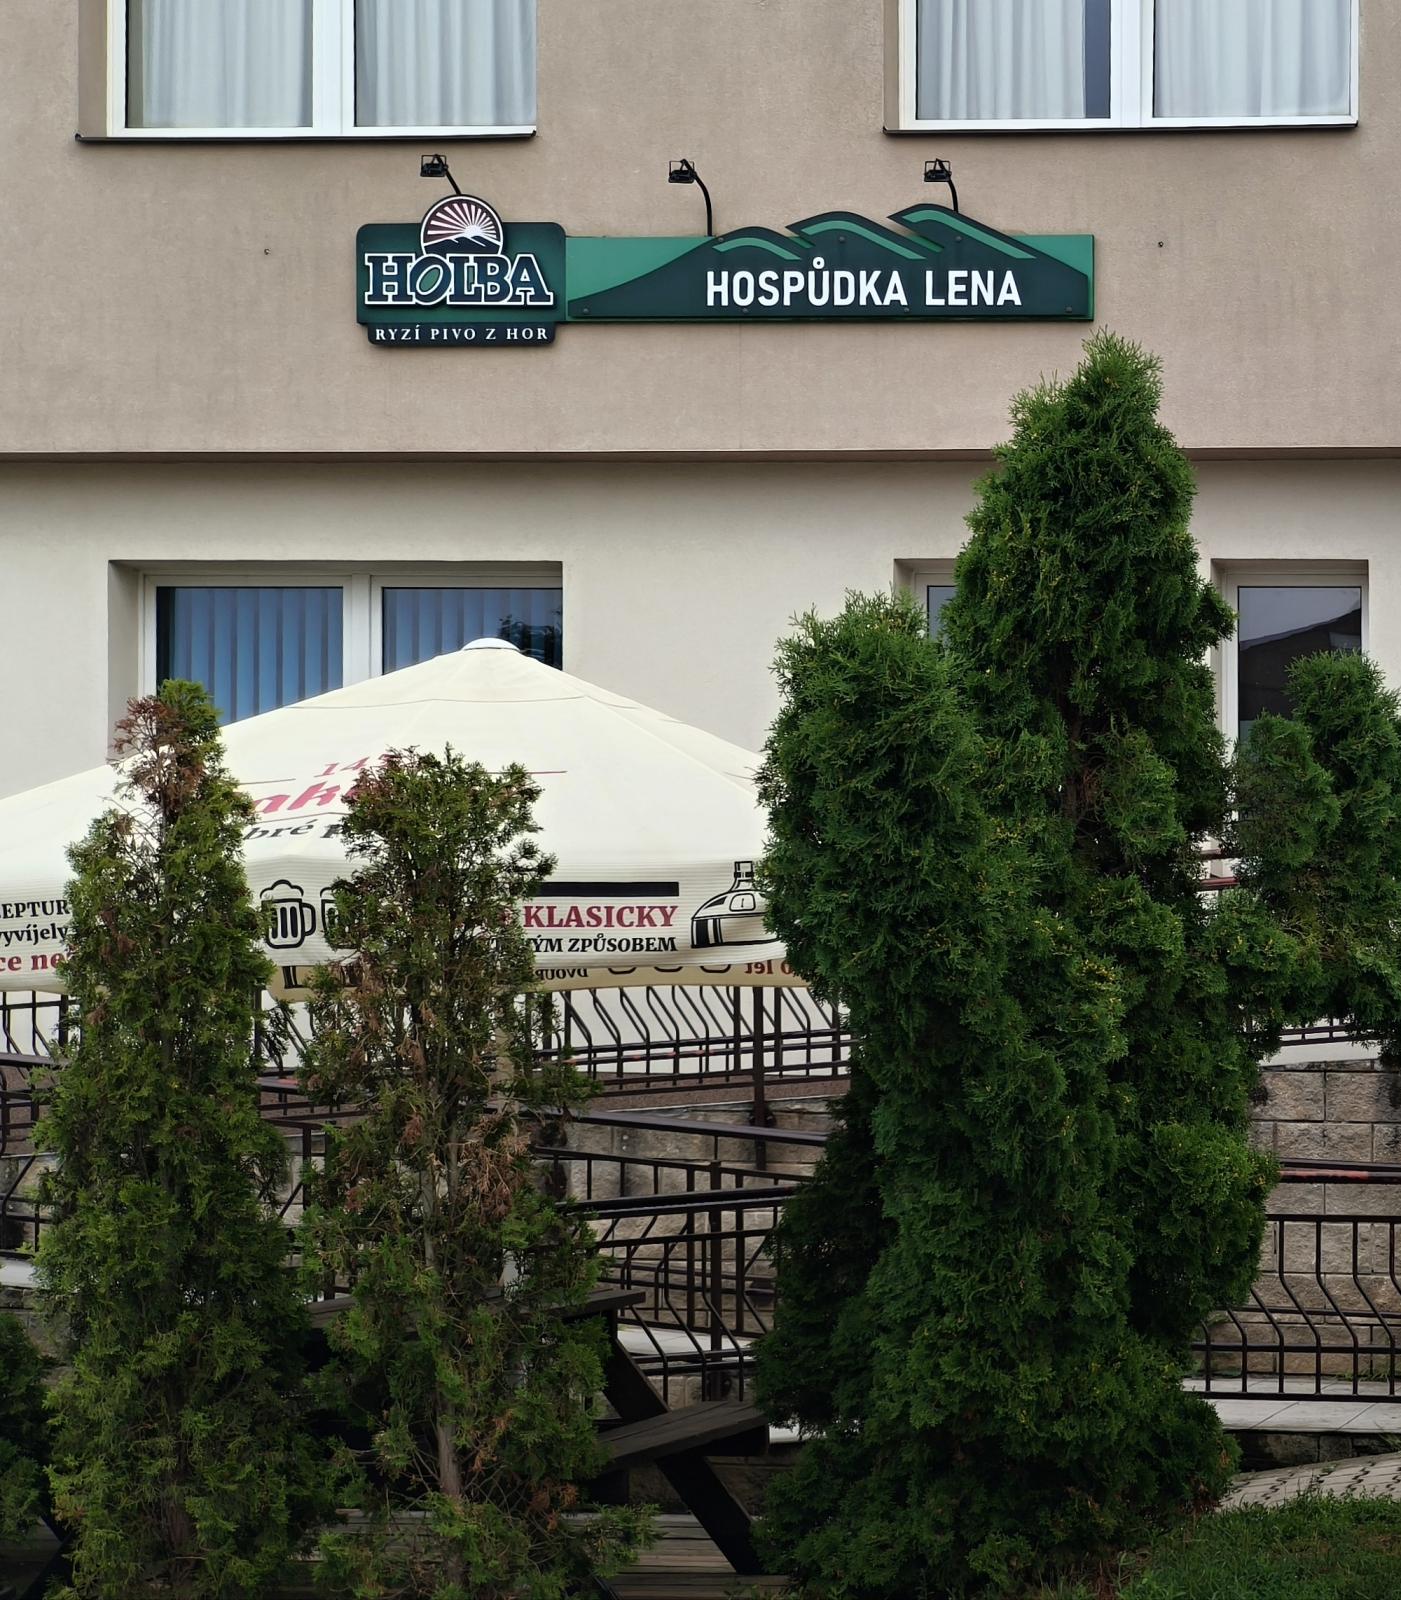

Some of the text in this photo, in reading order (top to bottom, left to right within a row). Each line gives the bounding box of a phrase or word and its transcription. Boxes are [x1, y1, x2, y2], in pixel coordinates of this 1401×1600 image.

[364, 253, 554, 306] HOLBA
[706, 256, 1022, 306] HOSPŮDKA LENA
[375, 324, 548, 341] RYZÍ PIVO Z HOR
[243, 819, 318, 840] bré
[523, 905, 679, 928] KLASICKY
[568, 932, 677, 952] ZPŮSOBEM
